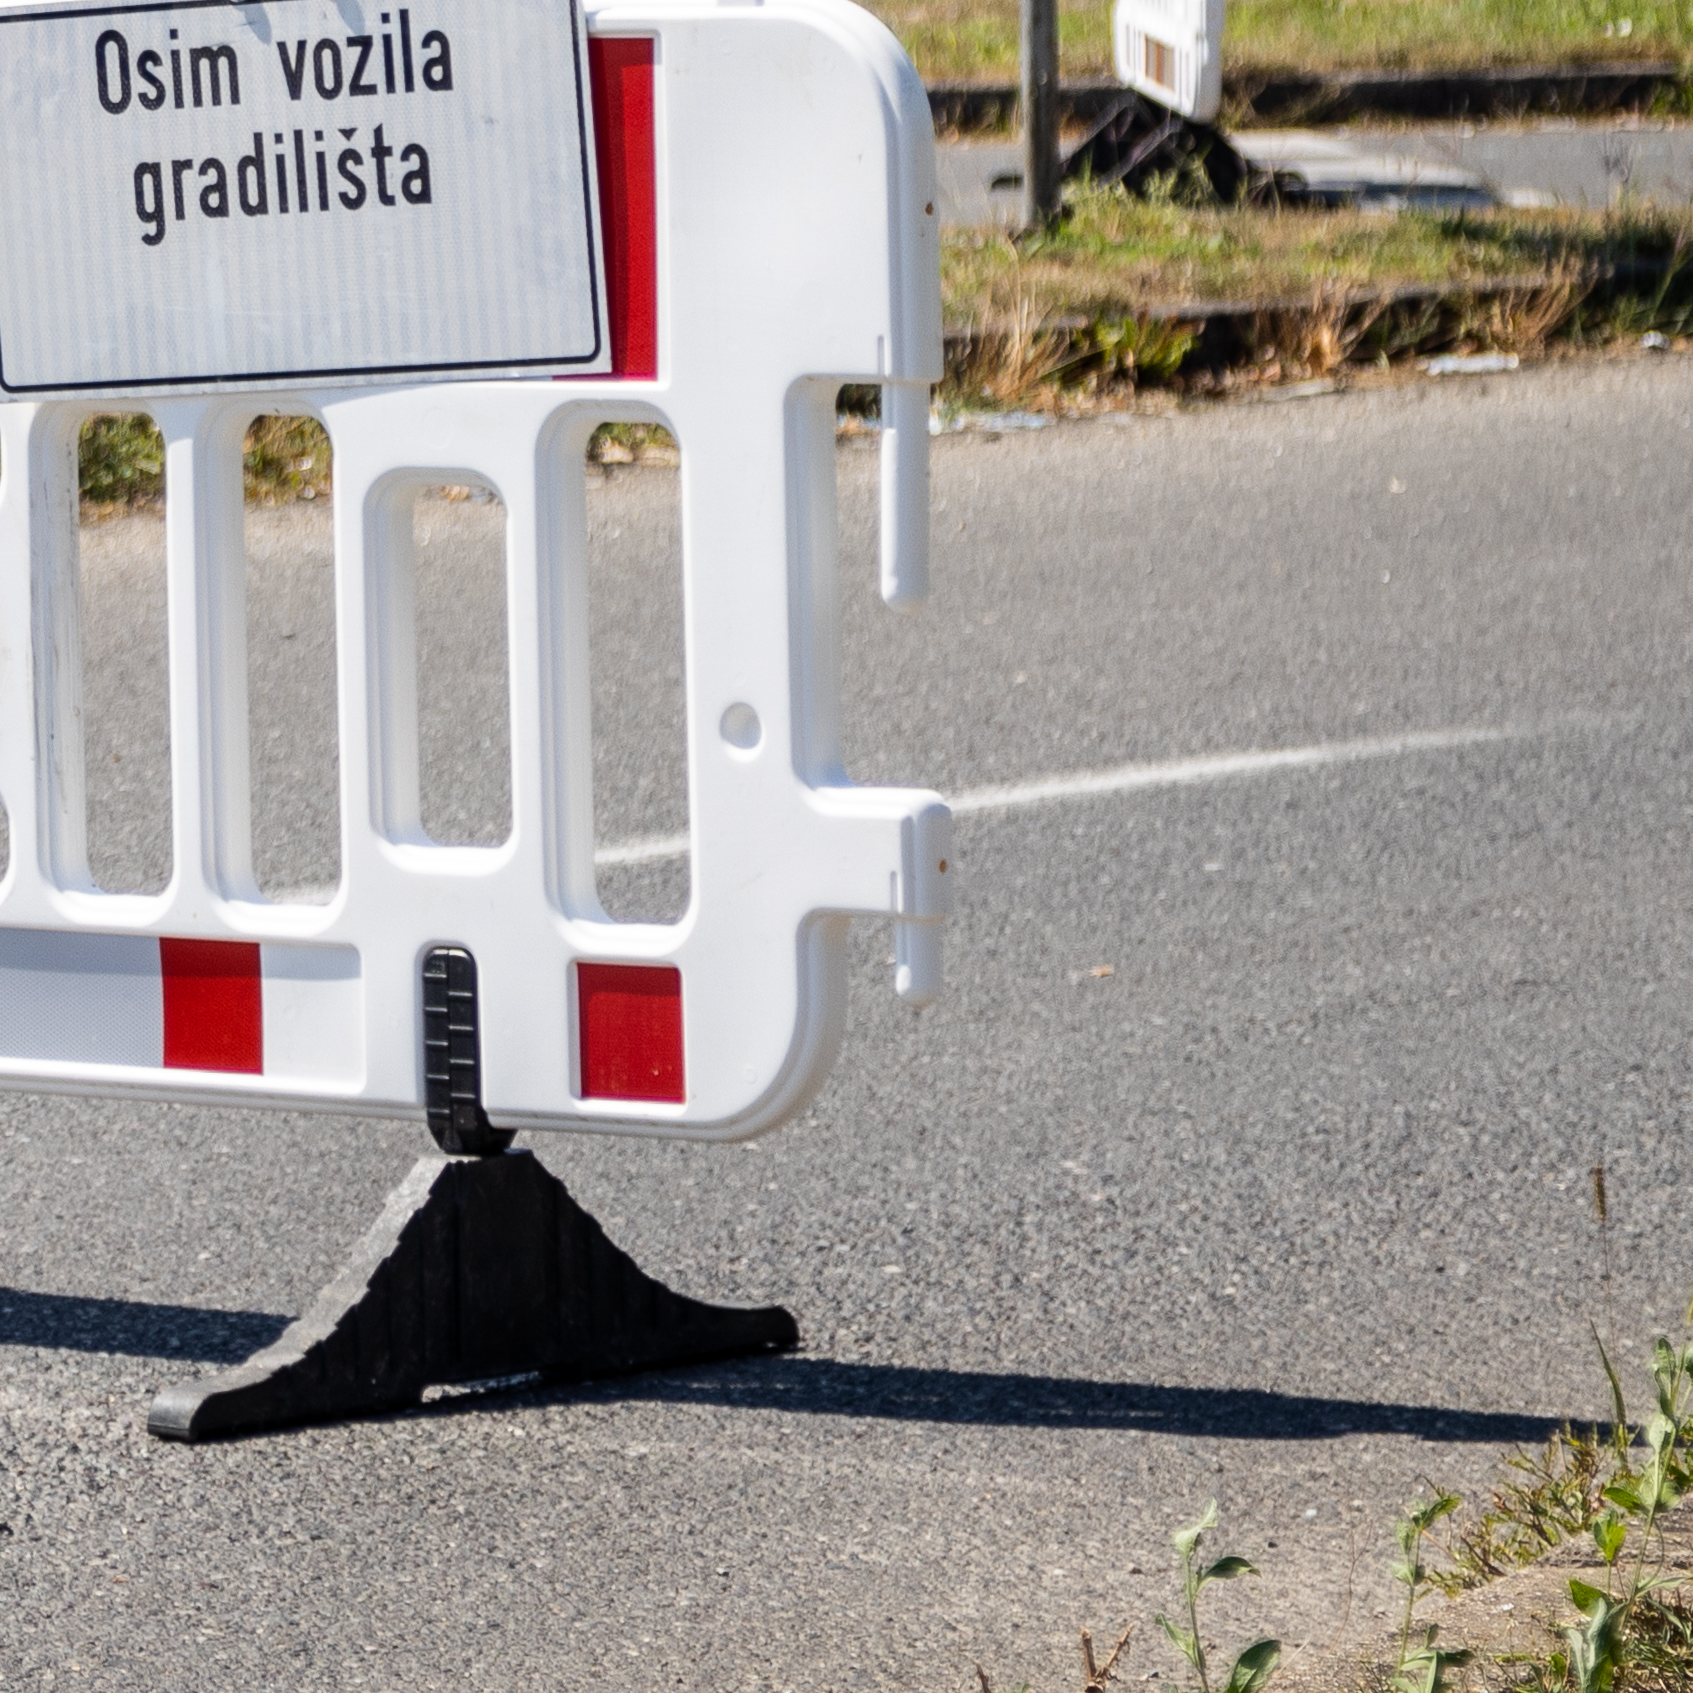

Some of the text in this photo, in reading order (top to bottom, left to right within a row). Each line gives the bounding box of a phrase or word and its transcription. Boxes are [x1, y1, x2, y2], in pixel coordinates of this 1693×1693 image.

[95, 8, 454, 115] Osim vozila
[133, 122, 433, 247] gradilišta
